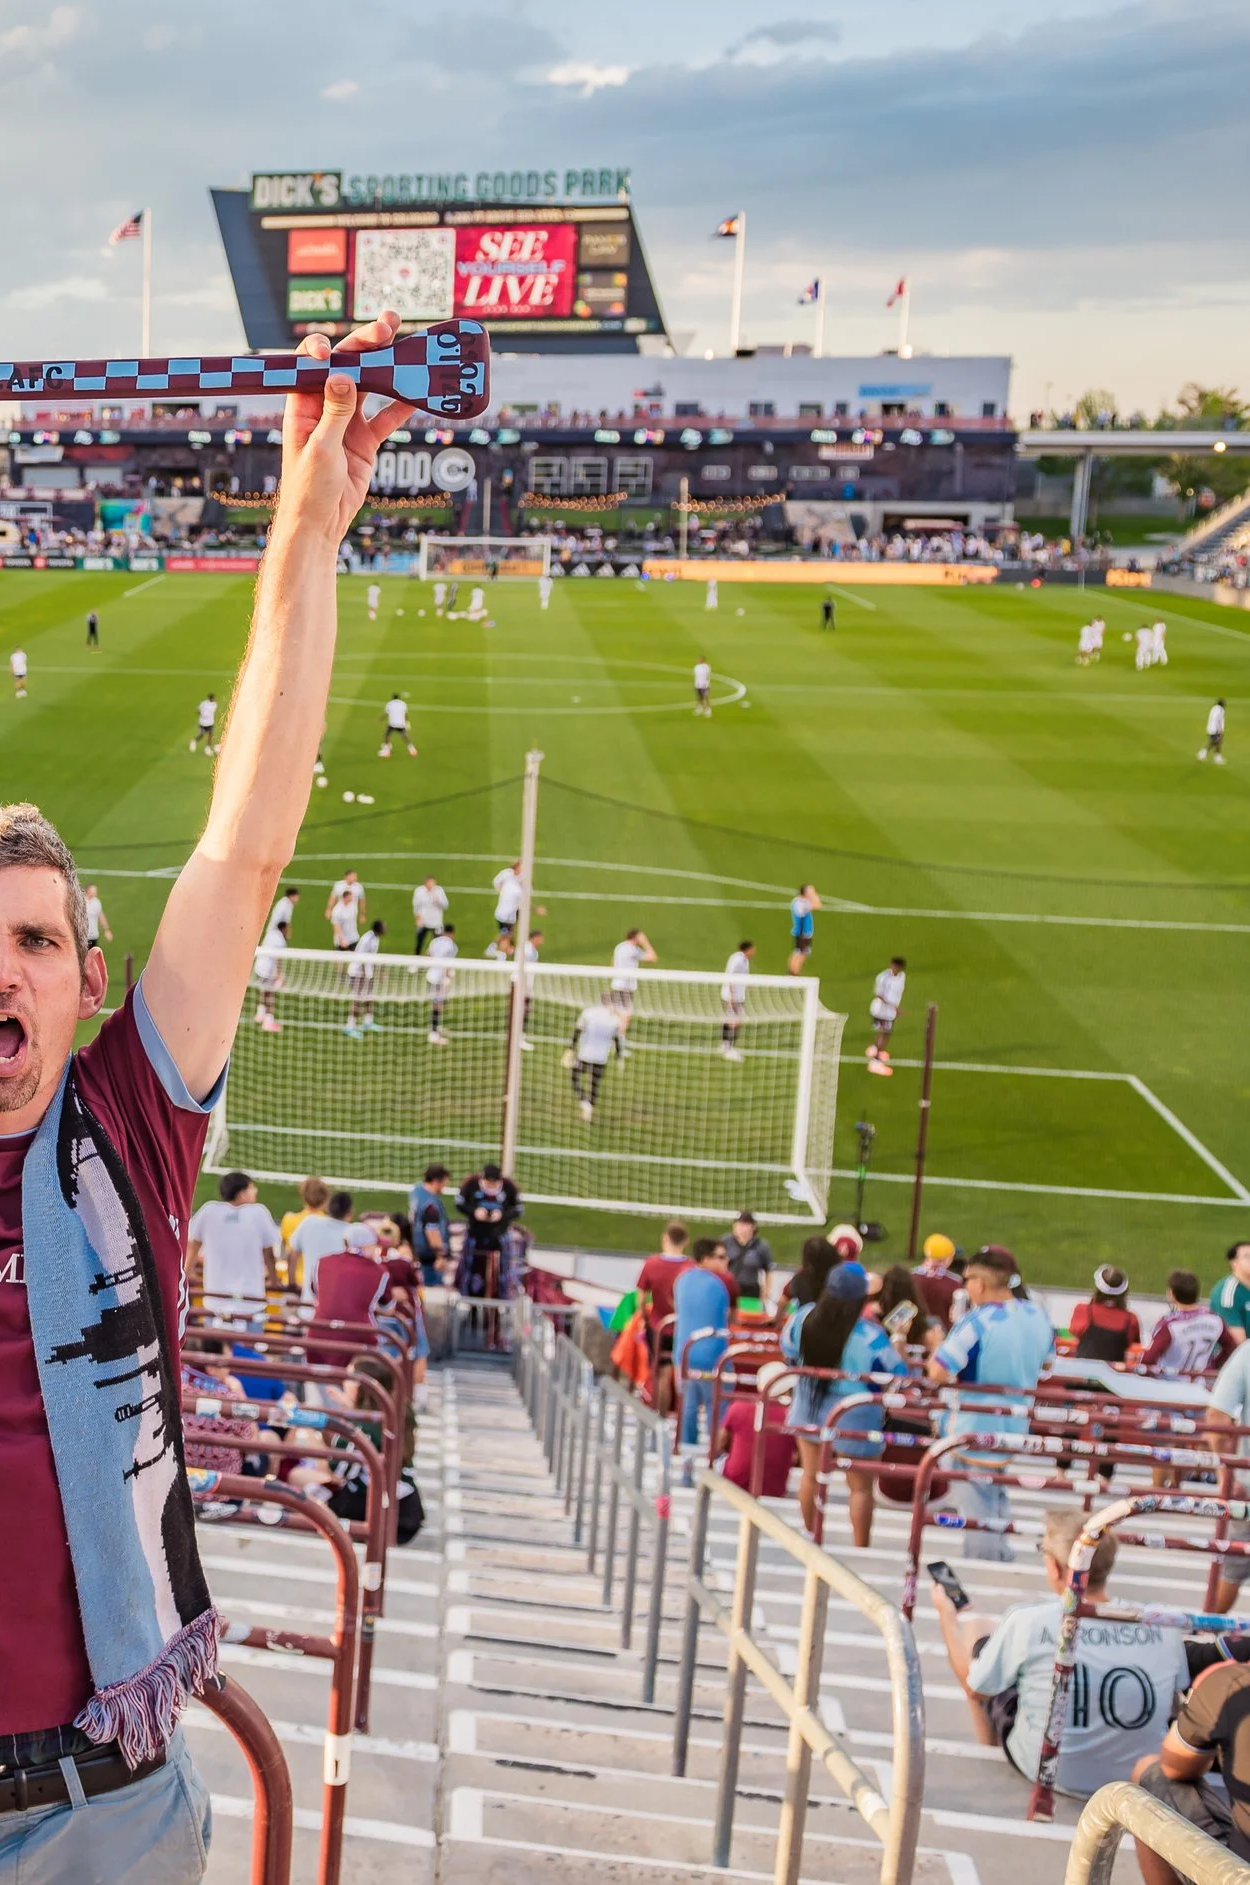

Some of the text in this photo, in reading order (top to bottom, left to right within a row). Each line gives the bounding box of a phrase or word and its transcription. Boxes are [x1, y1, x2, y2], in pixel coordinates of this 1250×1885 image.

[253, 167, 631, 207] DICK'S SPORTING GOODS PARK
[476, 230, 549, 261] SEE
[463, 274, 559, 307] LIVE
[1040, 1624, 1163, 1646] ARONSON
[1071, 1662, 1157, 1731] 10
